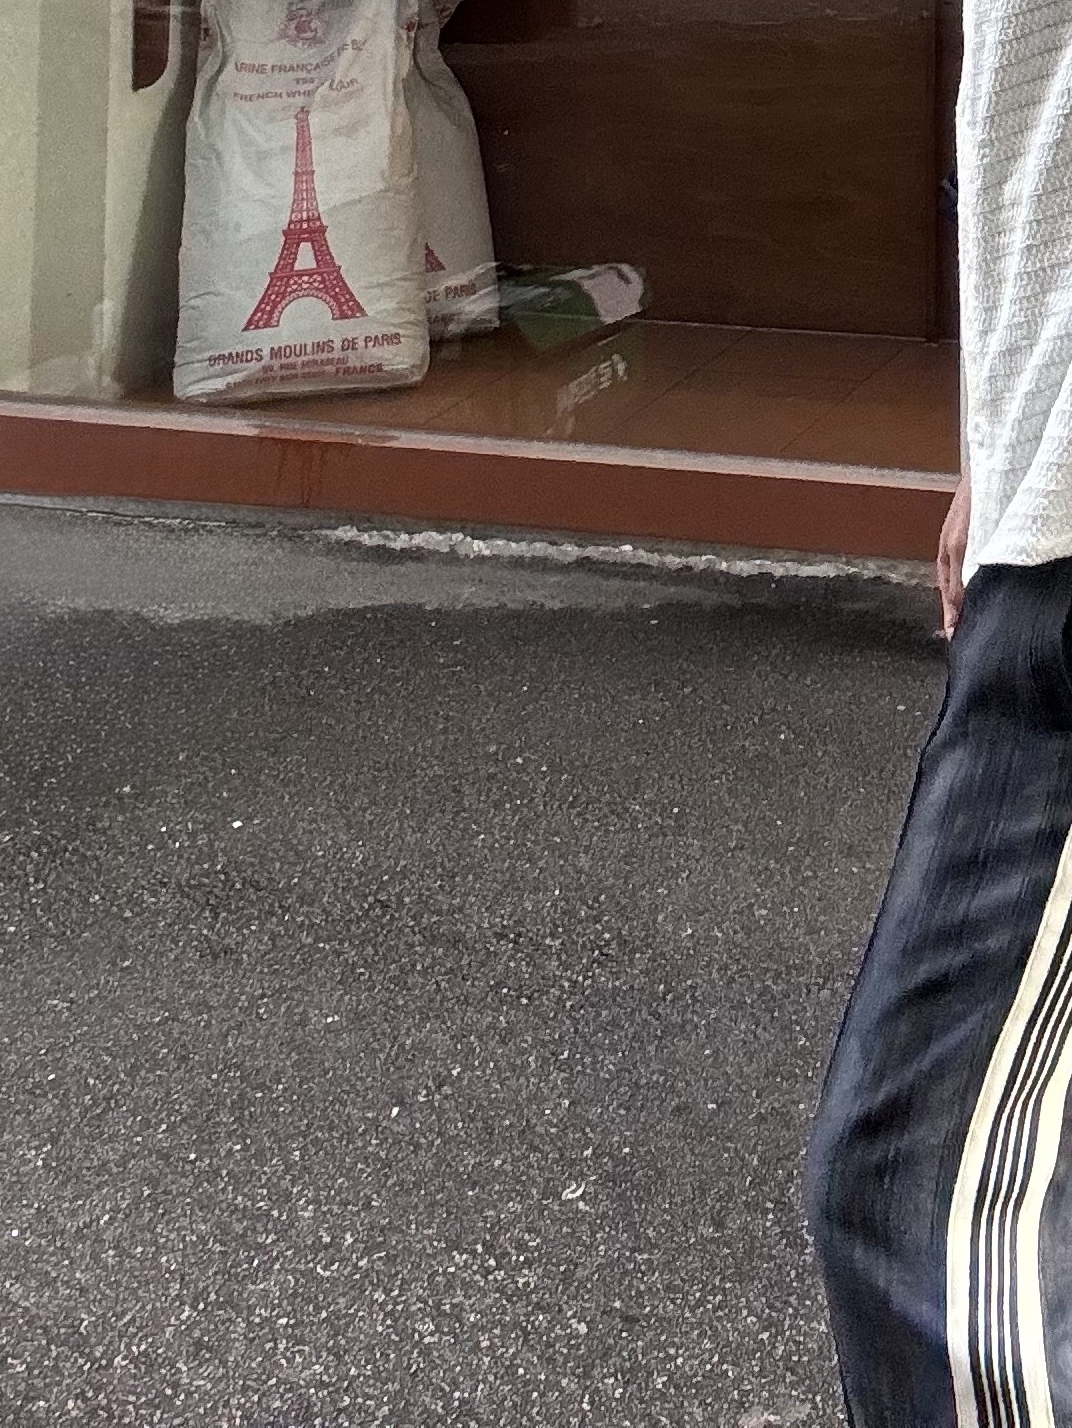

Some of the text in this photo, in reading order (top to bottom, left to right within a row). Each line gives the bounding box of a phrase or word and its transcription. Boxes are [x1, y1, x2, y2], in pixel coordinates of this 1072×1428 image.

[208, 332, 403, 367] GRANDS MOULINS DE PARIS
